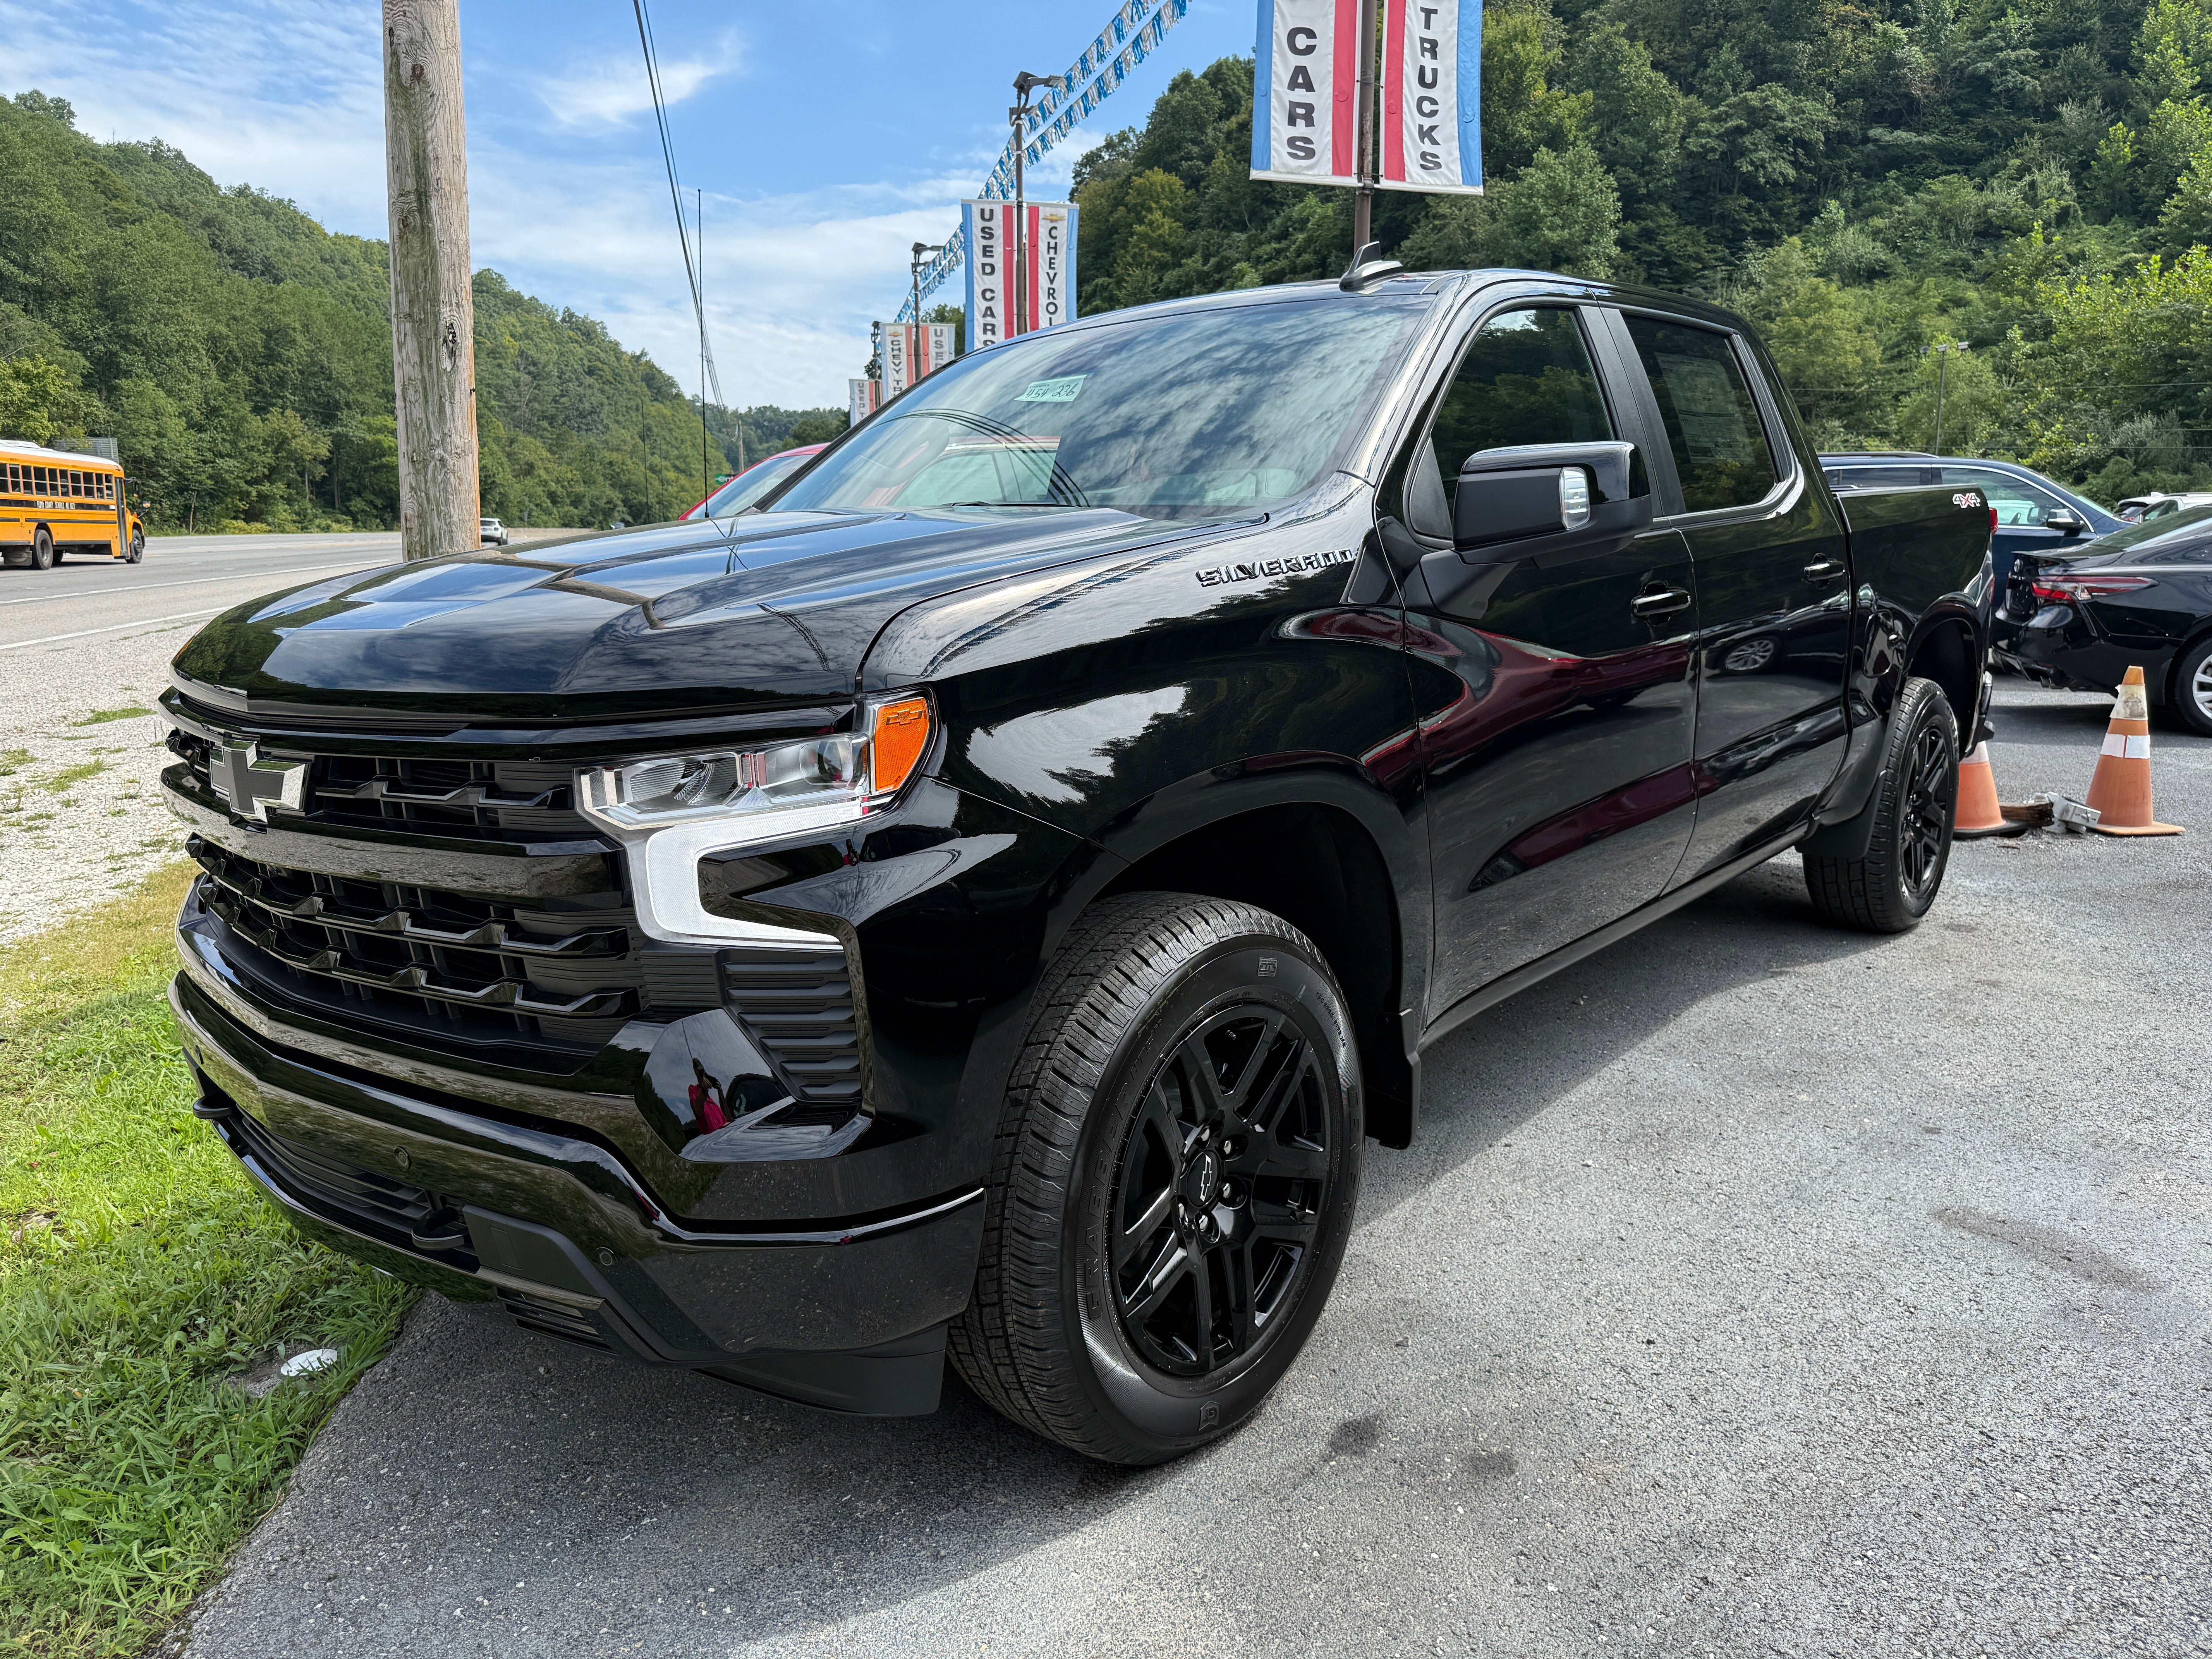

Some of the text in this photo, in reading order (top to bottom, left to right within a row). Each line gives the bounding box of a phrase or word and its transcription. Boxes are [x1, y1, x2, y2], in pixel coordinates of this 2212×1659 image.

[1286, 27, 1317, 160] CARS
[1416, 6, 1442, 170] TRUCKS
[980, 208, 995, 276] USED
[891, 340, 902, 374] CHEVY
[1052, 383, 1079, 397] 236
[1195, 548, 1354, 587] SILVERADO
